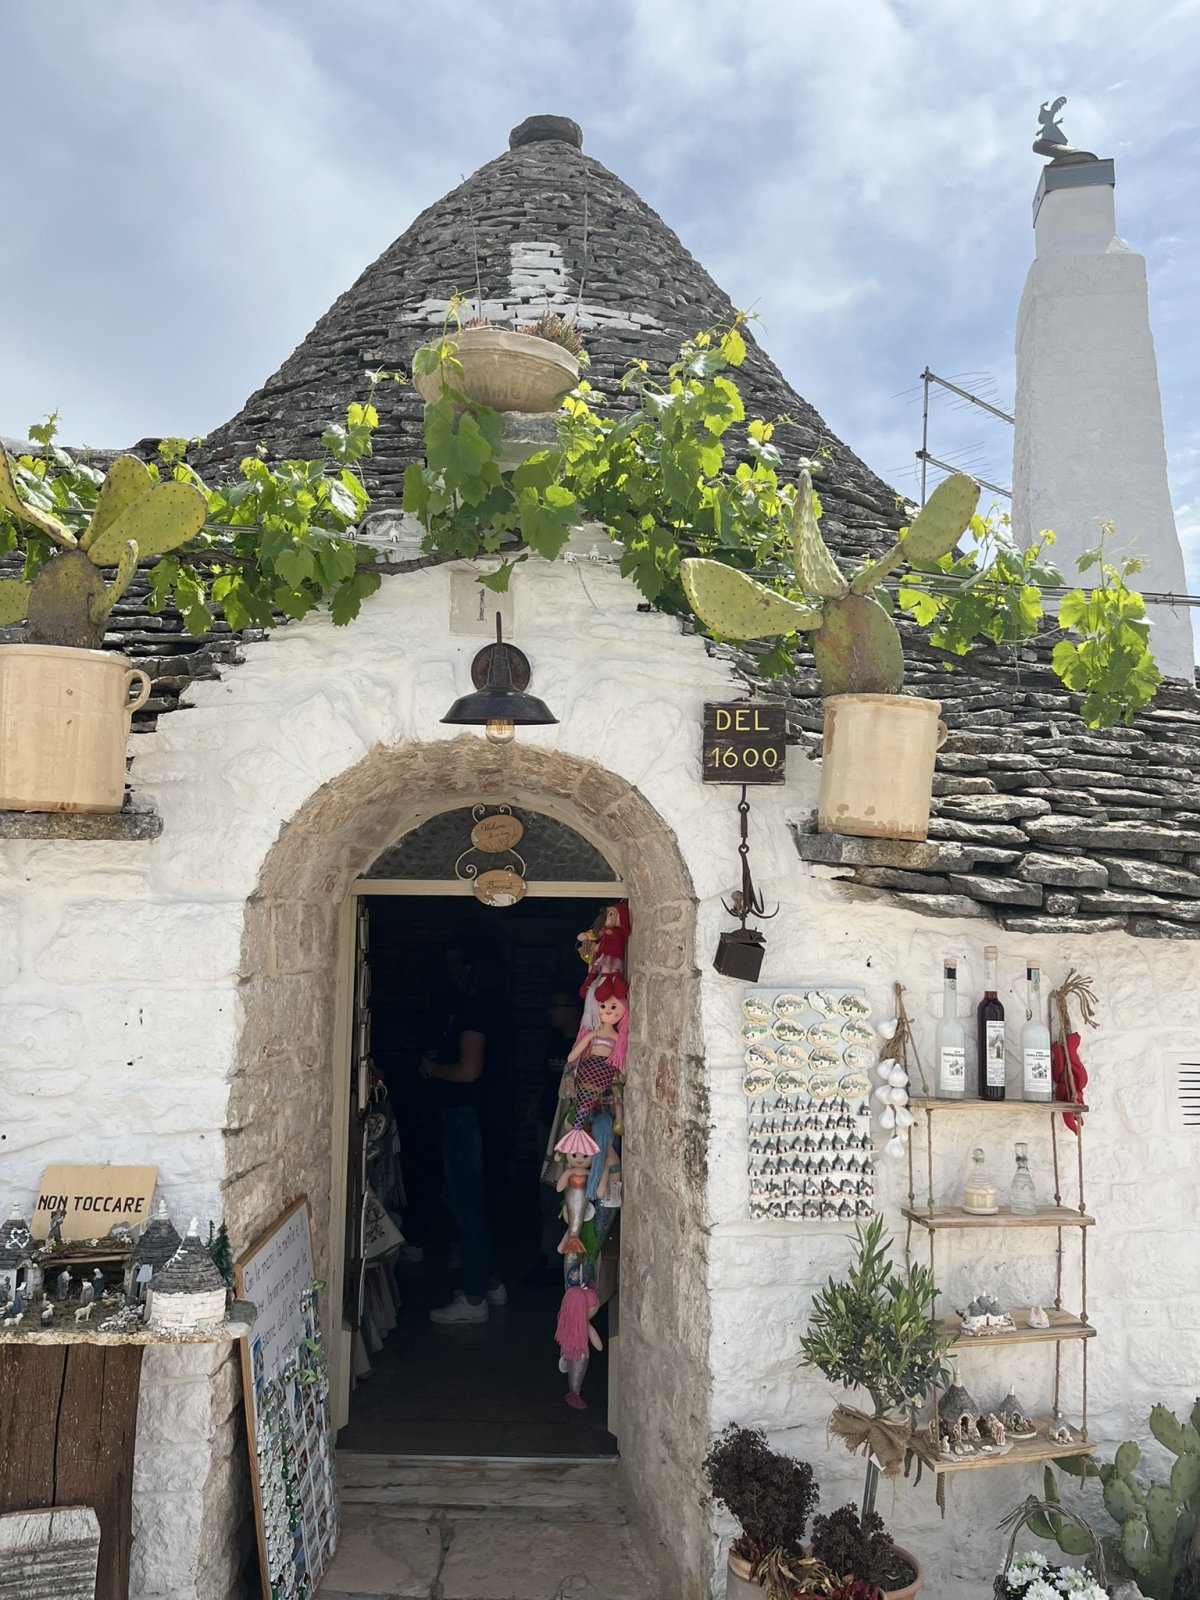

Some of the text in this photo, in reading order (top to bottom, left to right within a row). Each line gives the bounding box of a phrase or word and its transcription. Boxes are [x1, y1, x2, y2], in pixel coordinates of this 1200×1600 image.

[475, 588, 487, 622] 1
[716, 709, 770, 731] DEL
[711, 746, 778, 768] 1600
[38, 1195, 145, 1213] NON TOCCARE
